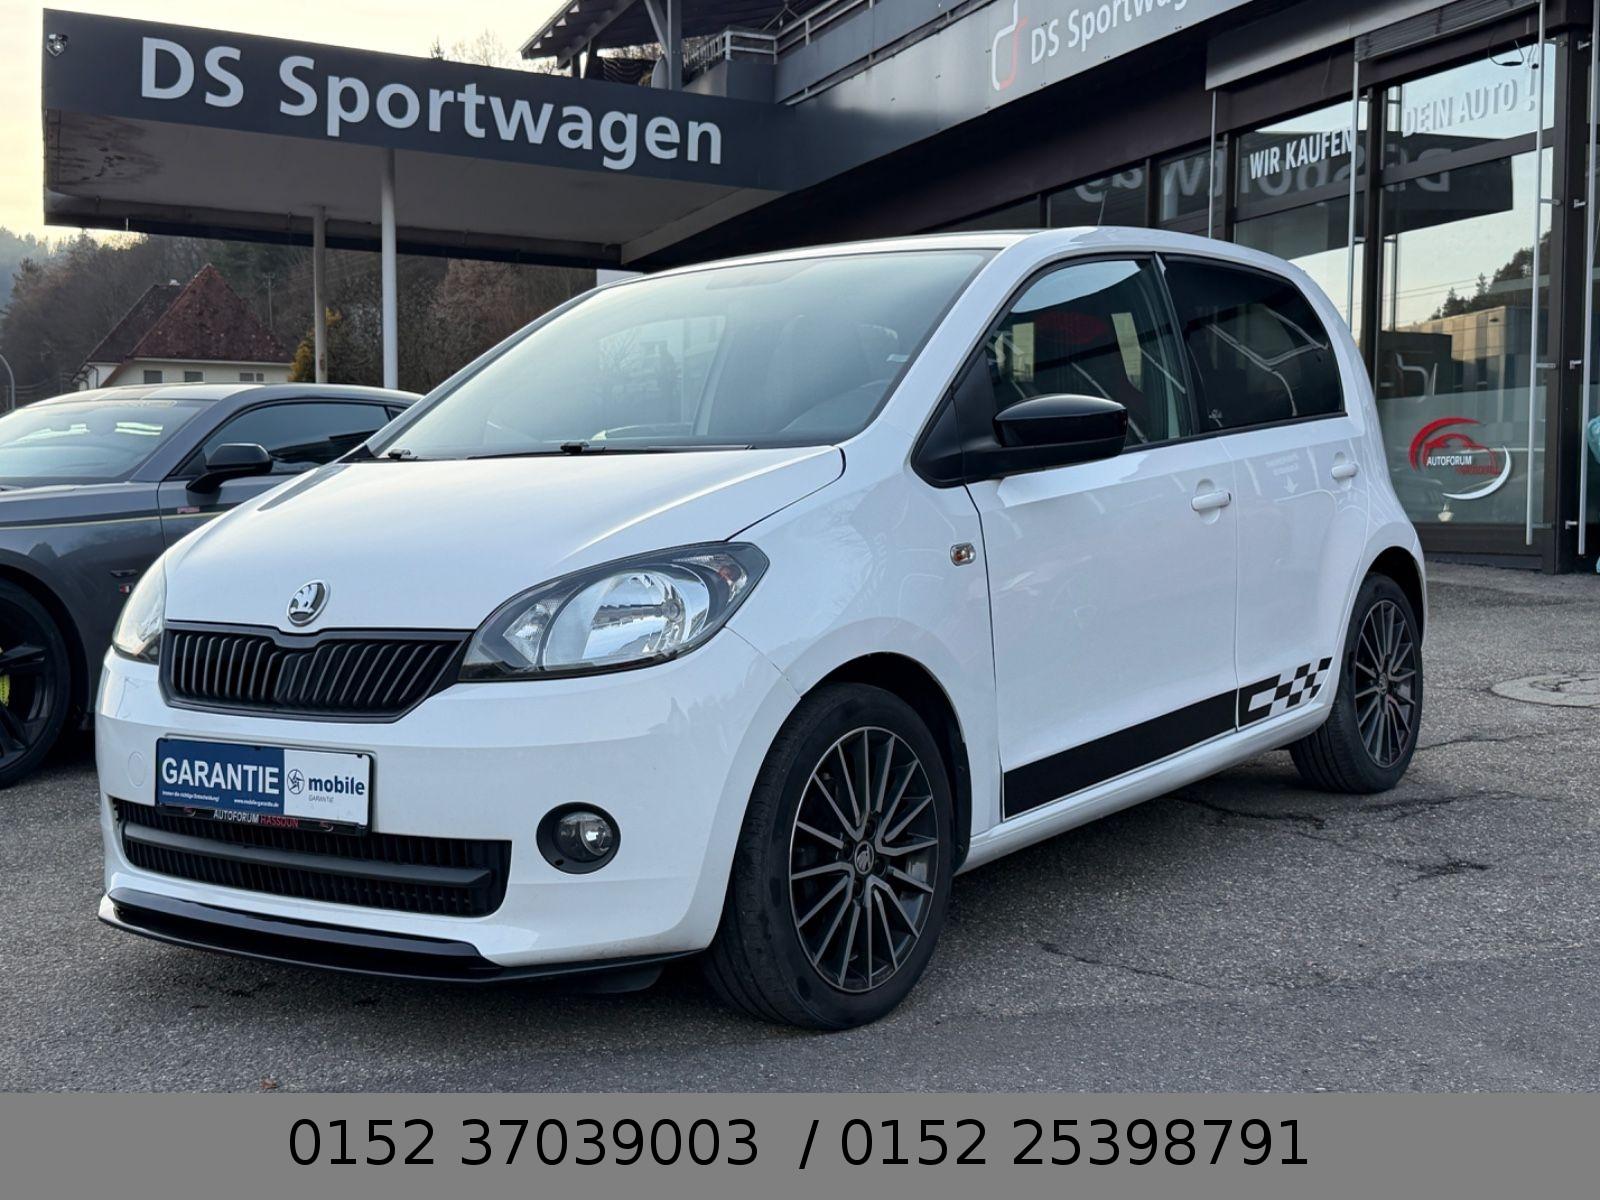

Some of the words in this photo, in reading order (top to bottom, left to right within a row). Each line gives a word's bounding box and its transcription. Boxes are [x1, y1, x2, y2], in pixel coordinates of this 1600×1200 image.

[1031, 19, 1060, 64] DS
[1068, 0, 1188, 52] Sportw
[140, 36, 244, 108] DS
[278, 55, 722, 170] Sportwagen
[1402, 96, 1453, 138] DEIN
[1457, 79, 1518, 123] AUTO
[1249, 146, 1281, 180] WIR
[1285, 128, 1353, 171] KAUFEN
[1426, 455, 1473, 466] AUTOFORUM
[161, 757, 280, 795] GARANTIE
[308, 775, 365, 796] mobile
[213, 809, 260, 824] AUTOFORUM
